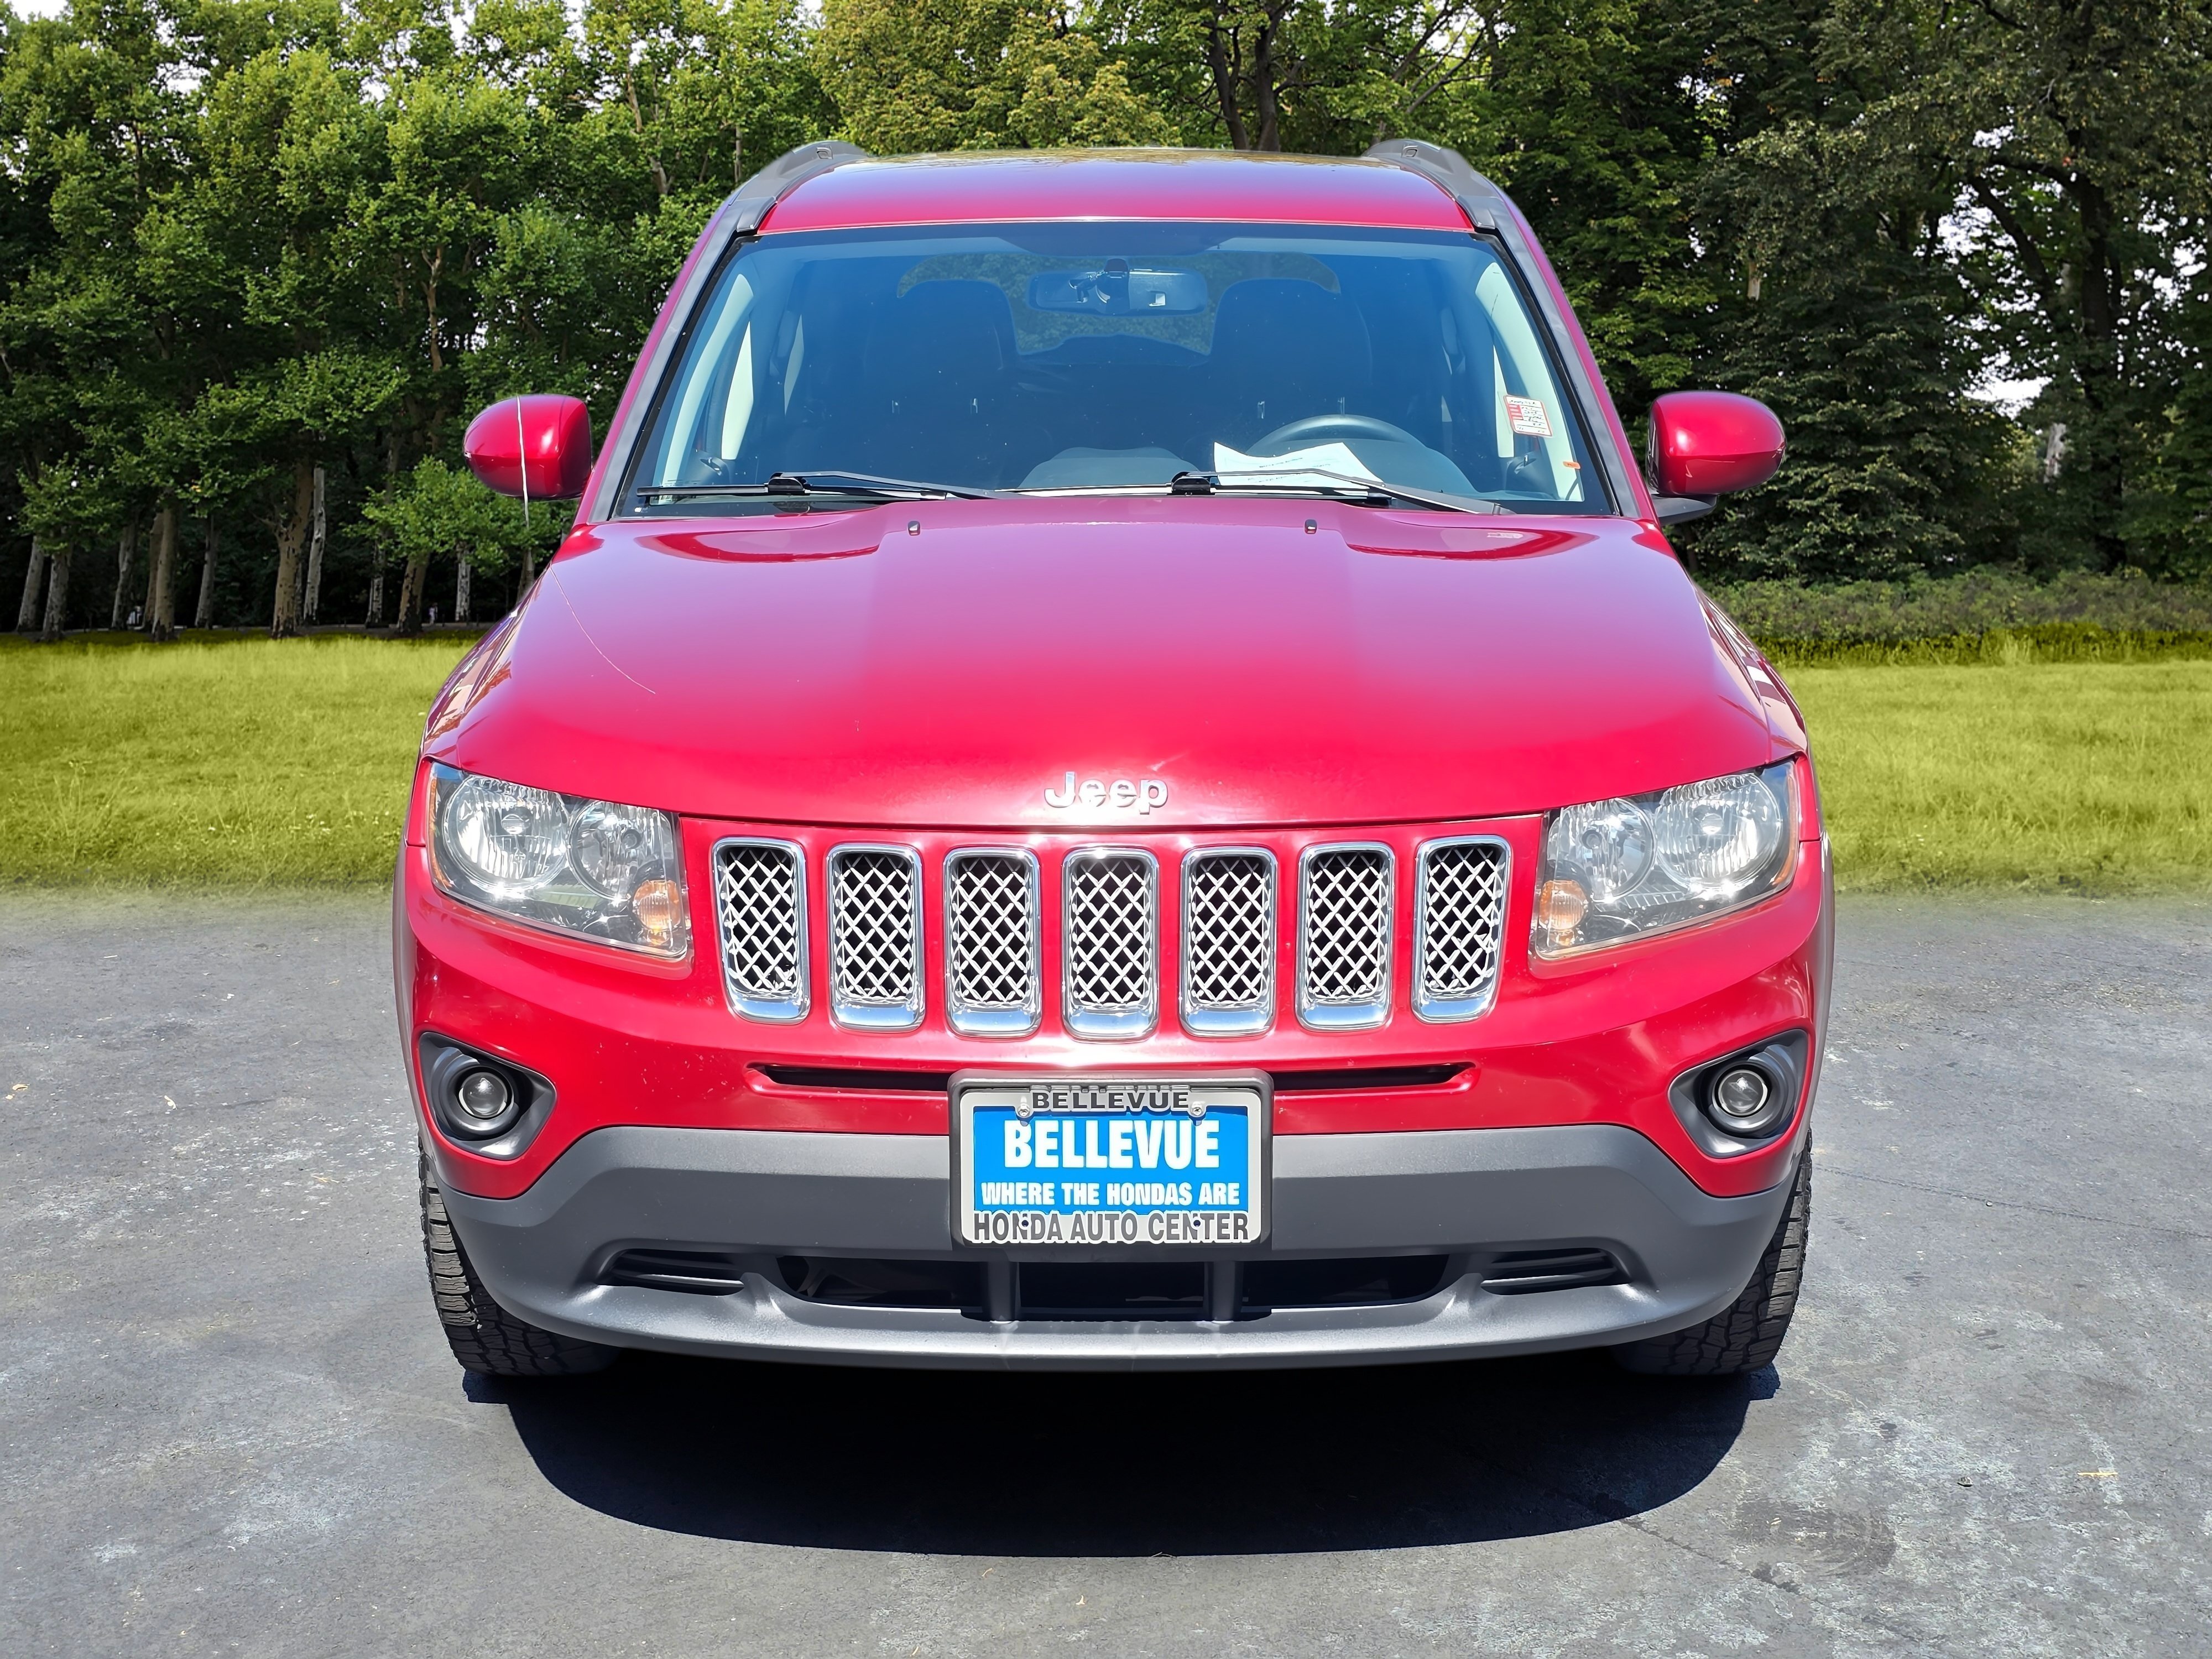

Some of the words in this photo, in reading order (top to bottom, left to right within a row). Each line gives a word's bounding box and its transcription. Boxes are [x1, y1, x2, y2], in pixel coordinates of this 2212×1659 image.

[1044, 771, 1168, 815] Jeep
[1032, 1092, 1190, 1109] BELLEVUE
[1004, 1120, 1220, 1169] BELLEVUE
[981, 1182, 1055, 1206] WHERE
[1061, 1182, 1100, 1206] THE
[1107, 1182, 1192, 1206] HONDAS
[1198, 1182, 1240, 1206] ARE
[974, 1213, 1070, 1240] HONDA
[1071, 1213, 1138, 1240] AUTO
[1148, 1213, 1249, 1240] CENTER
